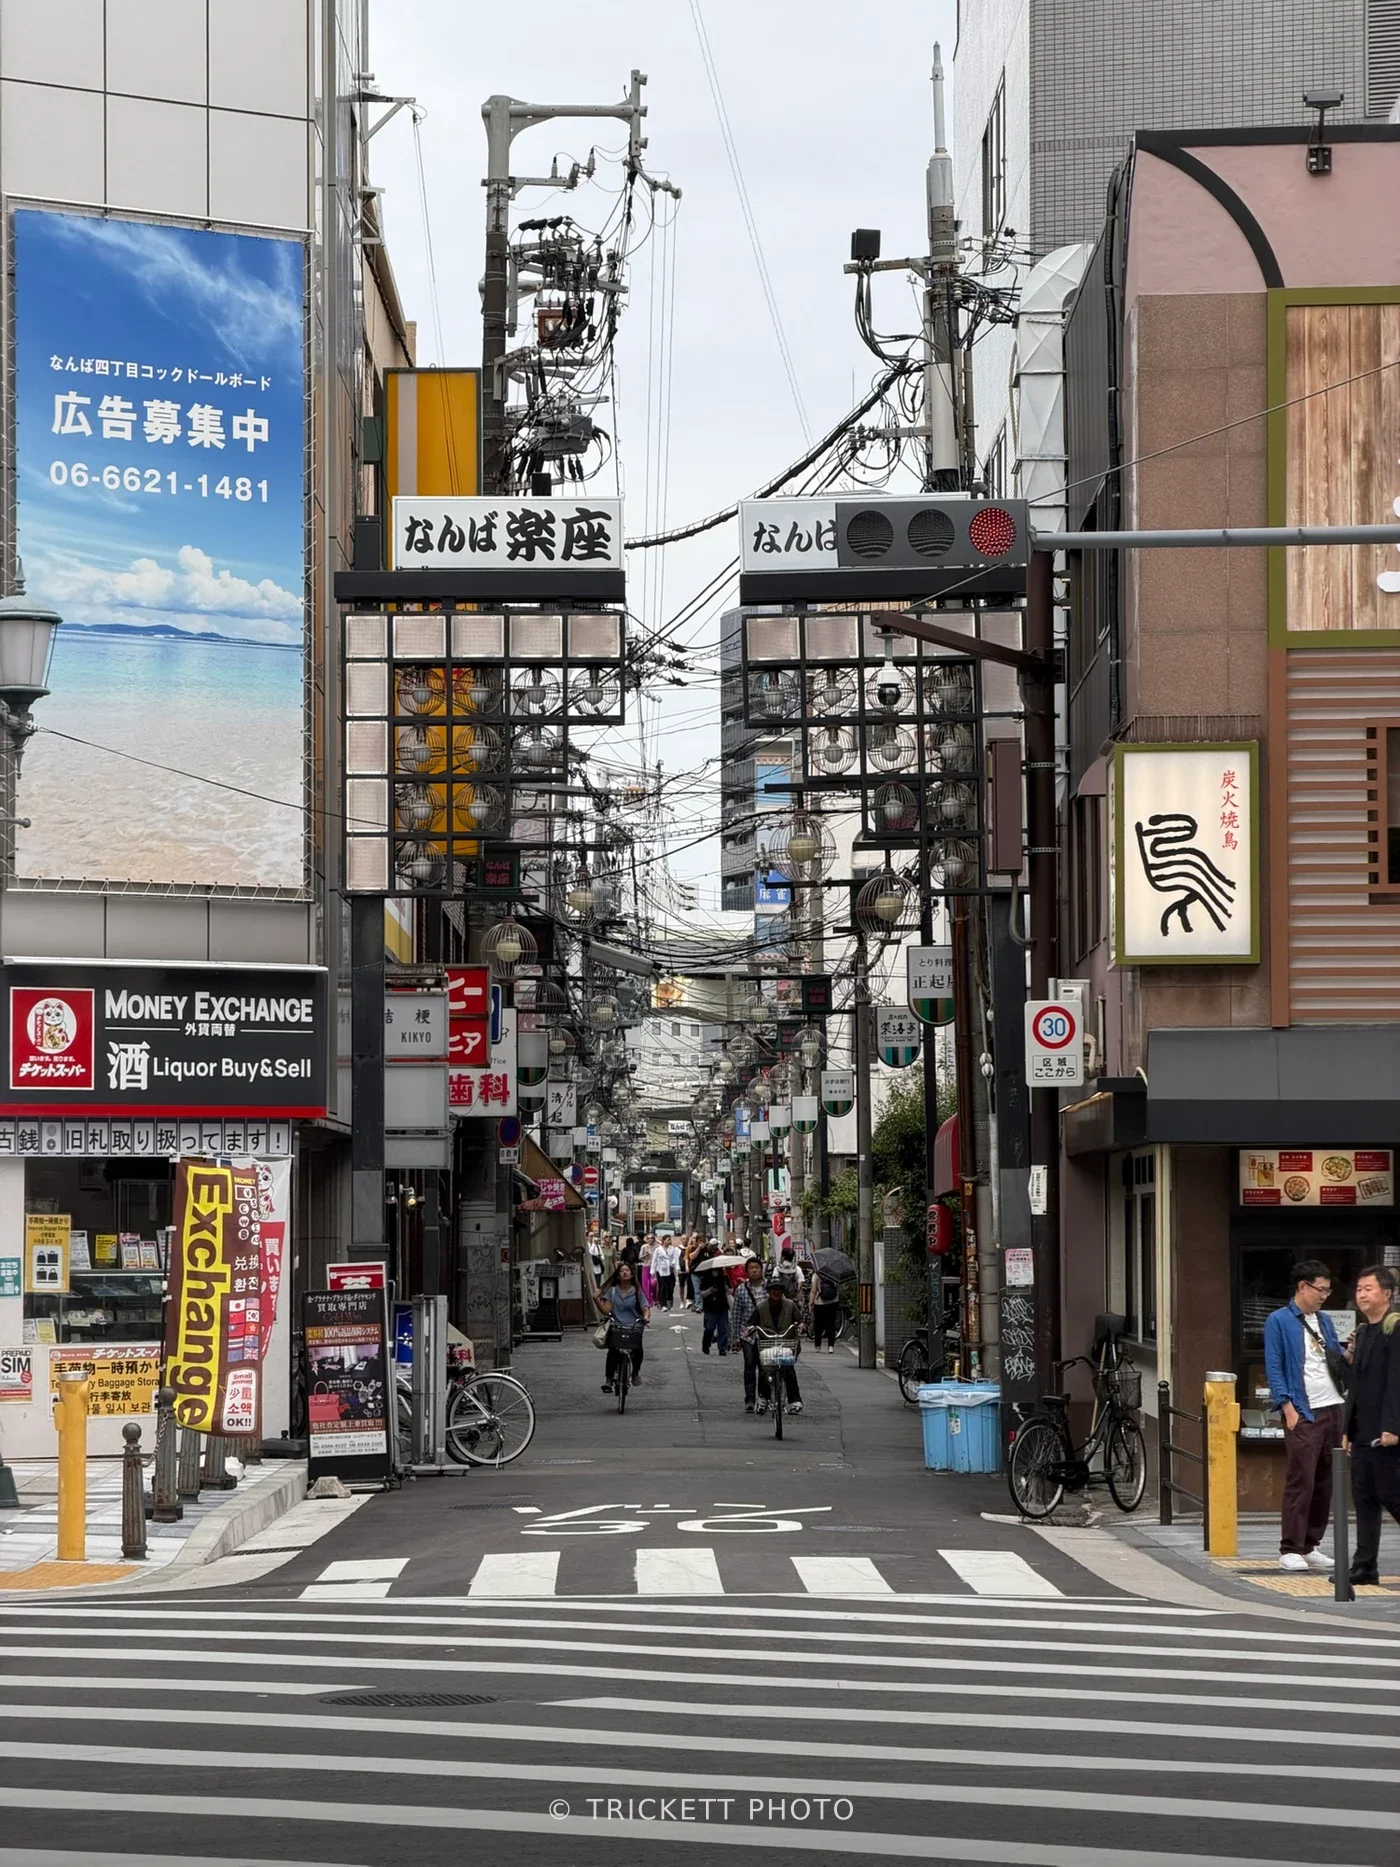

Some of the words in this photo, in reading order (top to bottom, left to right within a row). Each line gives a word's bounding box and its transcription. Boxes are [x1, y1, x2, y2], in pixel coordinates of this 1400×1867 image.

[50, 354, 272, 391] なんば四丁目コックドールボード
[51, 391, 269, 452] 広告募集中
[49, 461, 268, 502] 06-6621-1481
[405, 507, 612, 561] なんば楽座
[1220, 769, 1240, 850] 炭火焼鳥
[105, 989, 188, 1021] MONEY
[195, 991, 313, 1022] EXCHANGE
[185, 1023, 236, 1037] 外貨両替
[401, 1032, 431, 1043] KIKYO
[1042, 1018, 1066, 1037] 30
[19, 1063, 86, 1077] チケットスーパー
[107, 1041, 150, 1090] 酒
[154, 1057, 216, 1081] Liquor
[221, 1058, 311, 1082] Buy&Sell
[1035, 1067, 1076, 1078] ここから
[1042, 1057, 1067, 1067] 区域
[449, 1073, 510, 1107] 歯科
[234, 1176, 256, 1185] MONEY
[169, 1172, 230, 1427] Exchange
[1, 1357, 31, 1374] SIM
[98, 1378, 135, 1389] Baggage
[137, 1376, 160, 1387] Stora
[227, 1418, 252, 1427] OK!!
